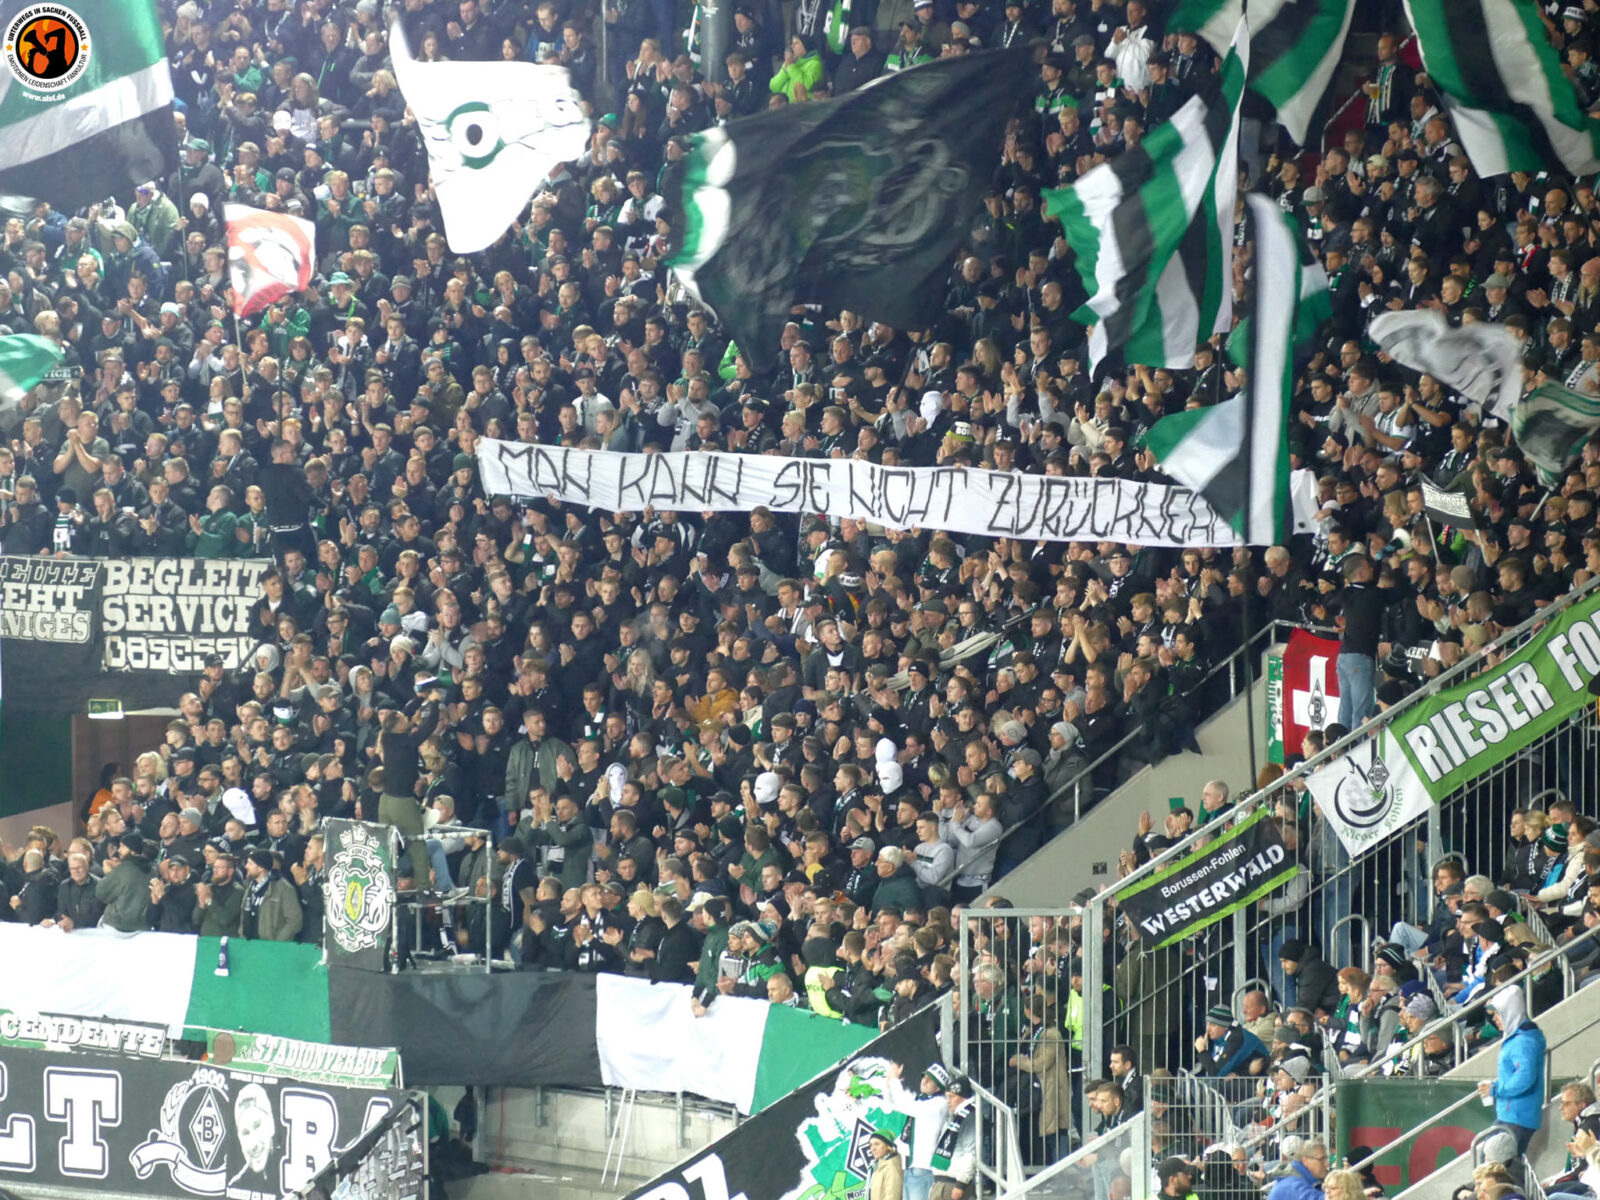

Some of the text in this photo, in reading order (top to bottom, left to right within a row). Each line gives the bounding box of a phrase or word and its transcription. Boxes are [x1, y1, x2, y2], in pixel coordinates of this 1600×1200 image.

[499, 444, 1237, 546] MAN KANN SIE NICHT ZURÜCKNEH
[0, 582, 84, 613] EHT
[103, 559, 268, 598] BEGLEIT
[1404, 661, 1555, 784] RIESER
[1140, 844, 1286, 936] WESTERWALD
[1161, 843, 1246, 898] Borussen-Fohlen
[0, 1012, 166, 1058] CENDENTE
[254, 1034, 387, 1076] STADIONVERBOT
